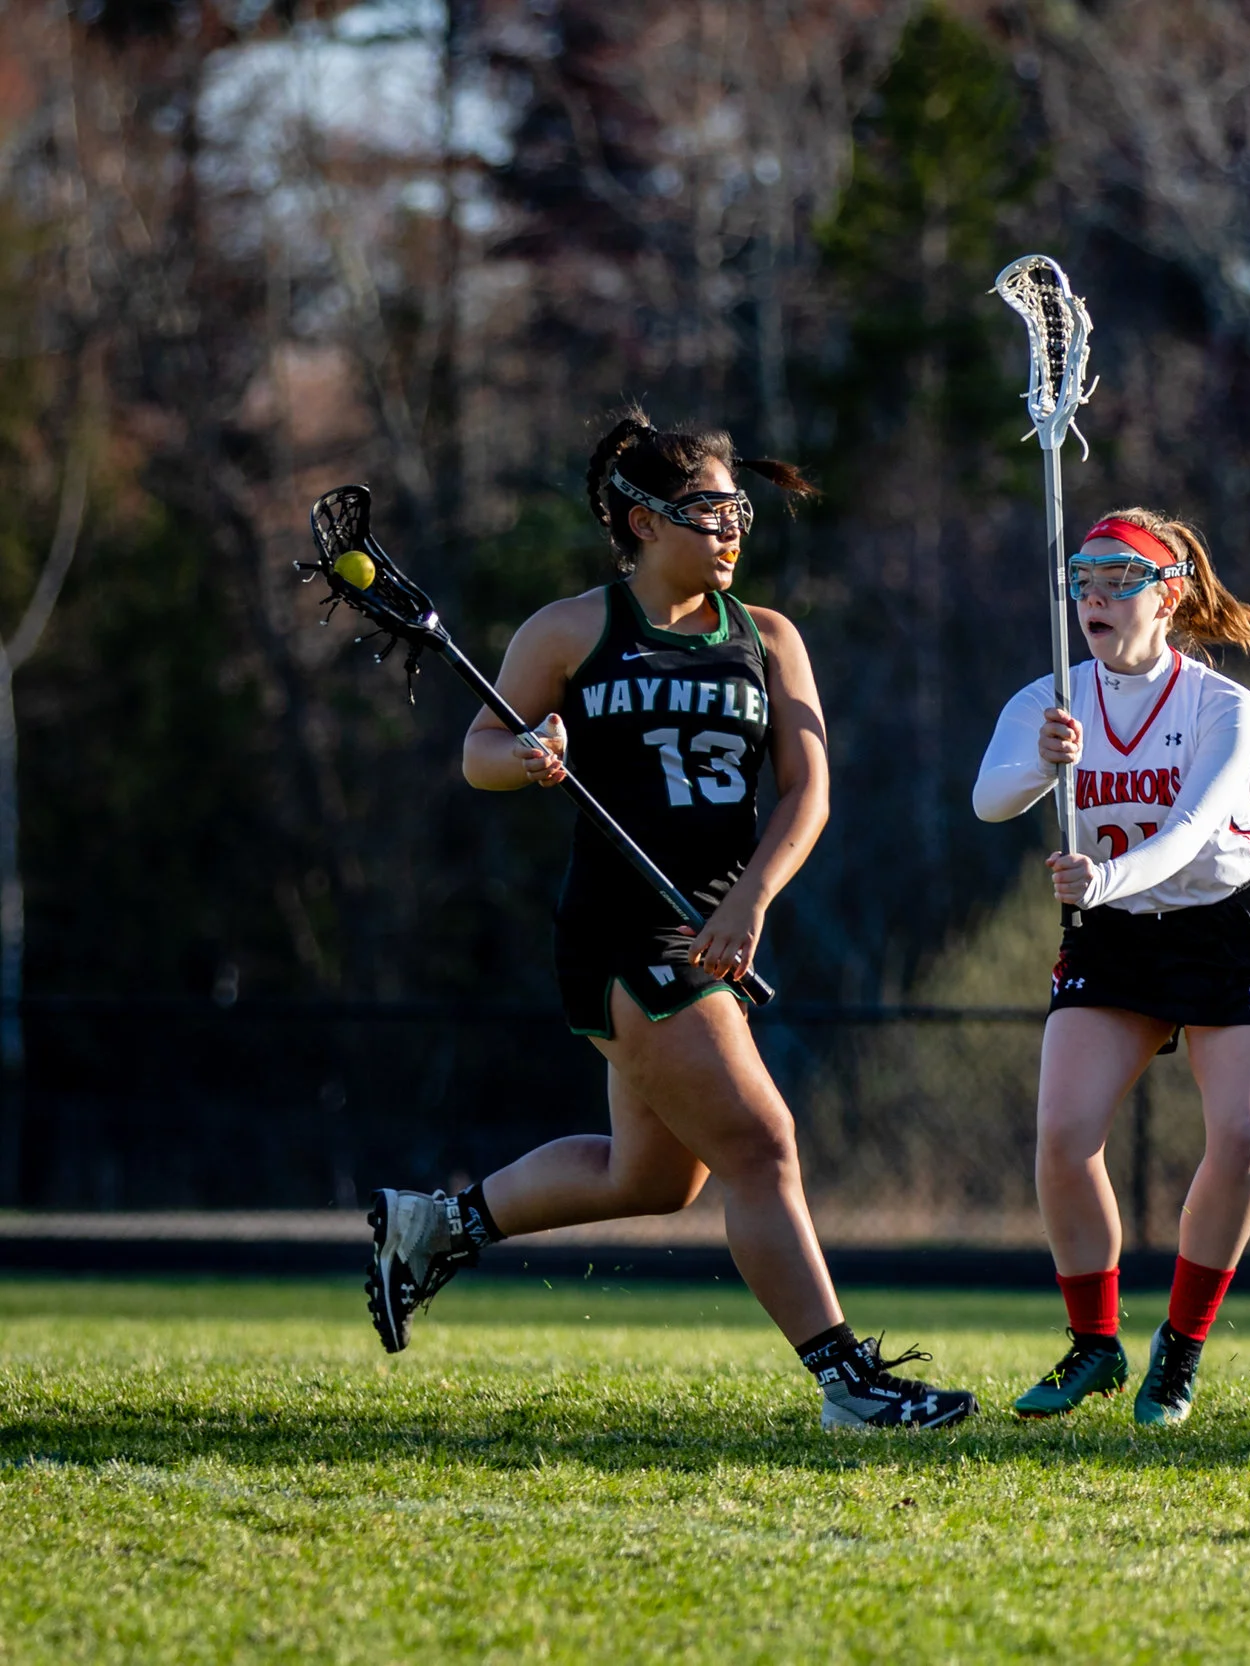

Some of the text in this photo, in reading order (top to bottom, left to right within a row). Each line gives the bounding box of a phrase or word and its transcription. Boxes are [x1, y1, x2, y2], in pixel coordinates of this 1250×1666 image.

[620, 480, 653, 506] STX
[1164, 566, 1182, 579] STX
[643, 727, 748, 807] 13
